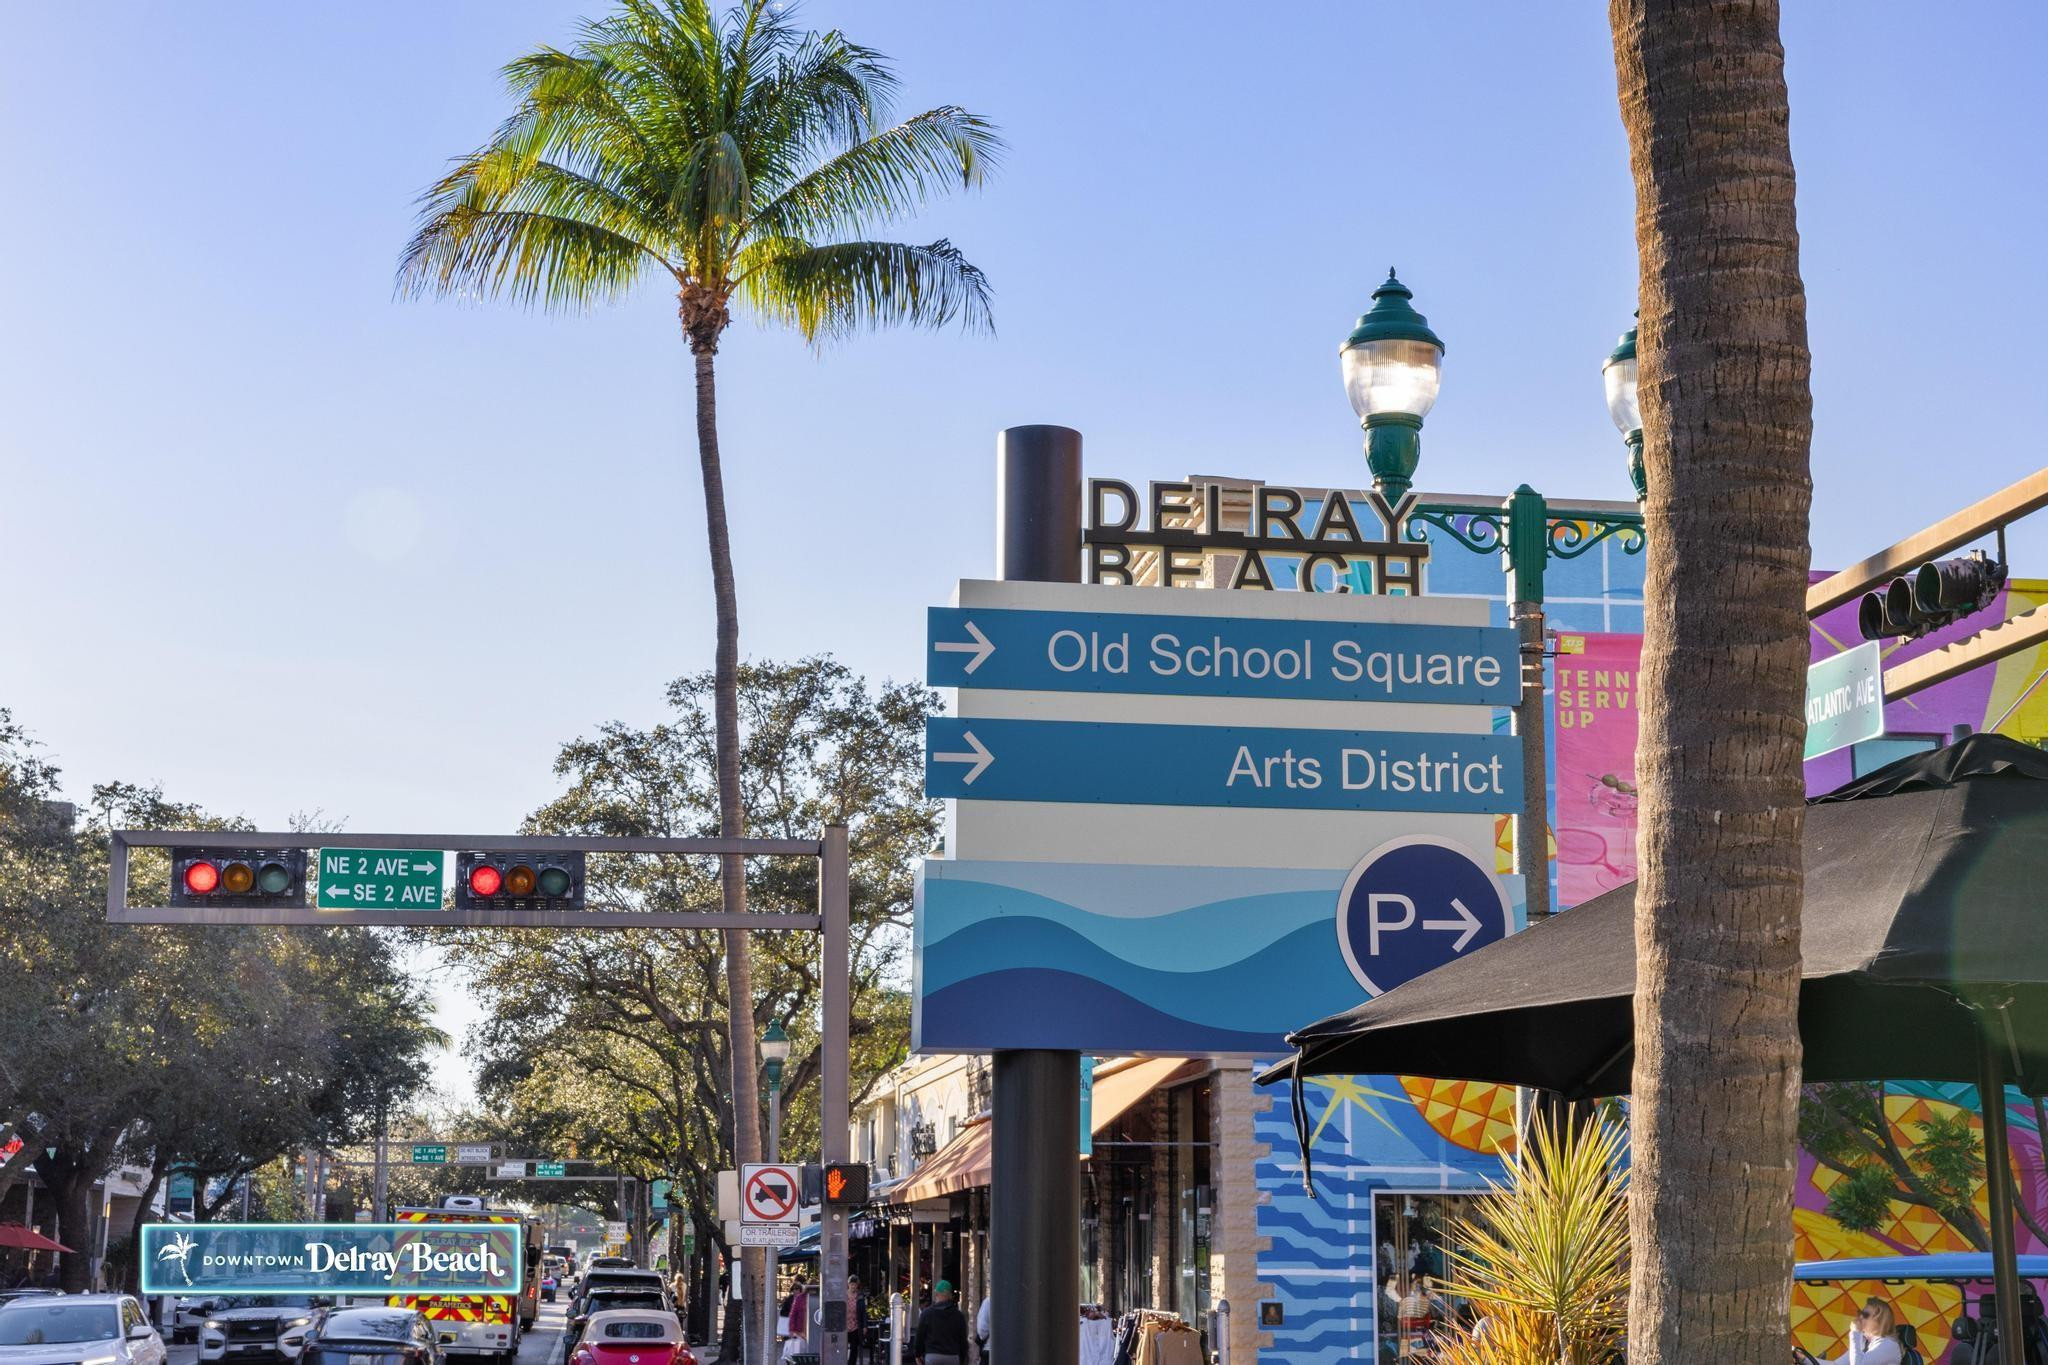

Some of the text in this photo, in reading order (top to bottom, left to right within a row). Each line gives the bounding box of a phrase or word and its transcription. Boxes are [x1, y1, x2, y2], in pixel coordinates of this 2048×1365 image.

[1088, 478, 1423, 544] DELRAY
[1088, 544, 1423, 597] BEACH
[1048, 630, 1501, 693] Old School Square
[1560, 711, 1594, 729] UP
[1807, 675, 1875, 726] ATLANTIC AVE
[1226, 745, 1504, 794] Arts District
[326, 856, 409, 876] NE 2 AVE
[353, 884, 436, 903] SE 2 AVE
[1368, 893, 1416, 956] P
[430, 1300, 472, 1309] PARAMEDICS
